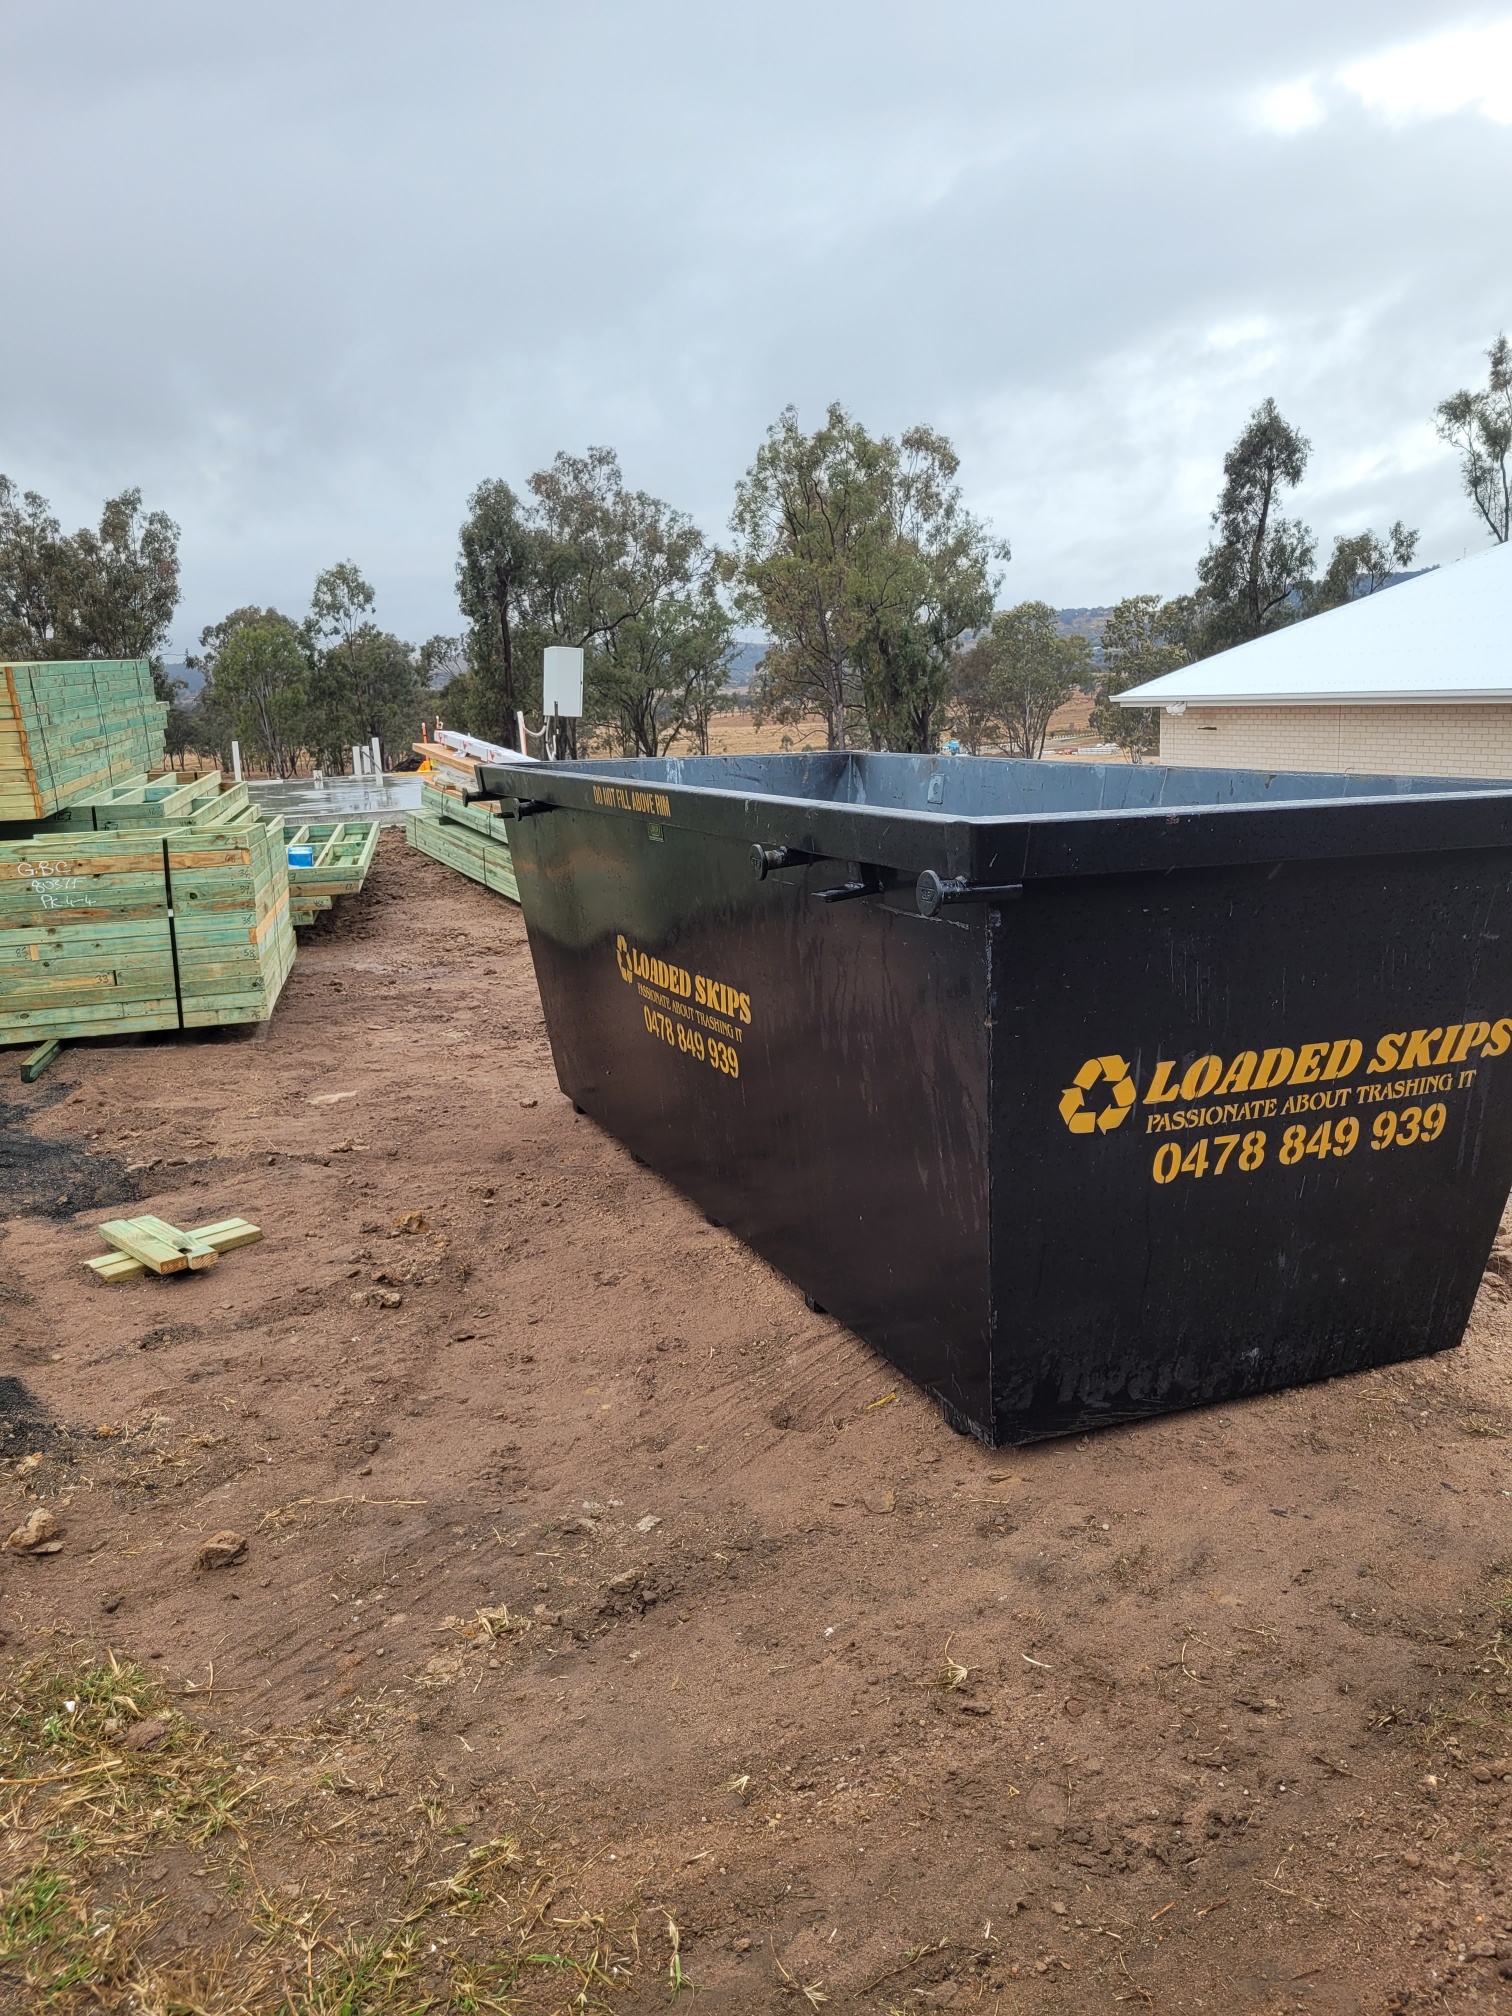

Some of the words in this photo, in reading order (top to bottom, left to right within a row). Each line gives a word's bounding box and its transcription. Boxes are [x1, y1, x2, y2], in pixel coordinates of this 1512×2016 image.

[602, 786, 617, 808] NOT
[616, 788, 632, 810] FILL
[631, 791, 656, 815] ABOVE
[654, 794, 671, 817] RIM
[632, 948, 692, 998] LOADED
[695, 974, 752, 1025] SKIPS
[636, 981, 672, 1011] PASSIONATE
[672, 1000, 695, 1021] ABOUT
[695, 1010, 733, 1038] TRASHING
[734, 1027, 743, 1044] IT
[643, 1004, 675, 1047] 0478
[676, 1022, 705, 1062] 849
[707, 1037, 739, 1079] 939
[1142, 1039, 1364, 1105] LOADED
[1366, 1018, 1512, 1074] SKIPS
[1145, 1098, 1278, 1134] PASSIONATE
[1280, 1087, 1351, 1116] ABOUT
[1357, 1073, 1453, 1104] TRASHING
[1456, 1069, 1477, 1089] IT
[1152, 1130, 1267, 1185] 0478
[1278, 1115, 1361, 1166] 849
[1370, 1102, 1448, 1152] 939
